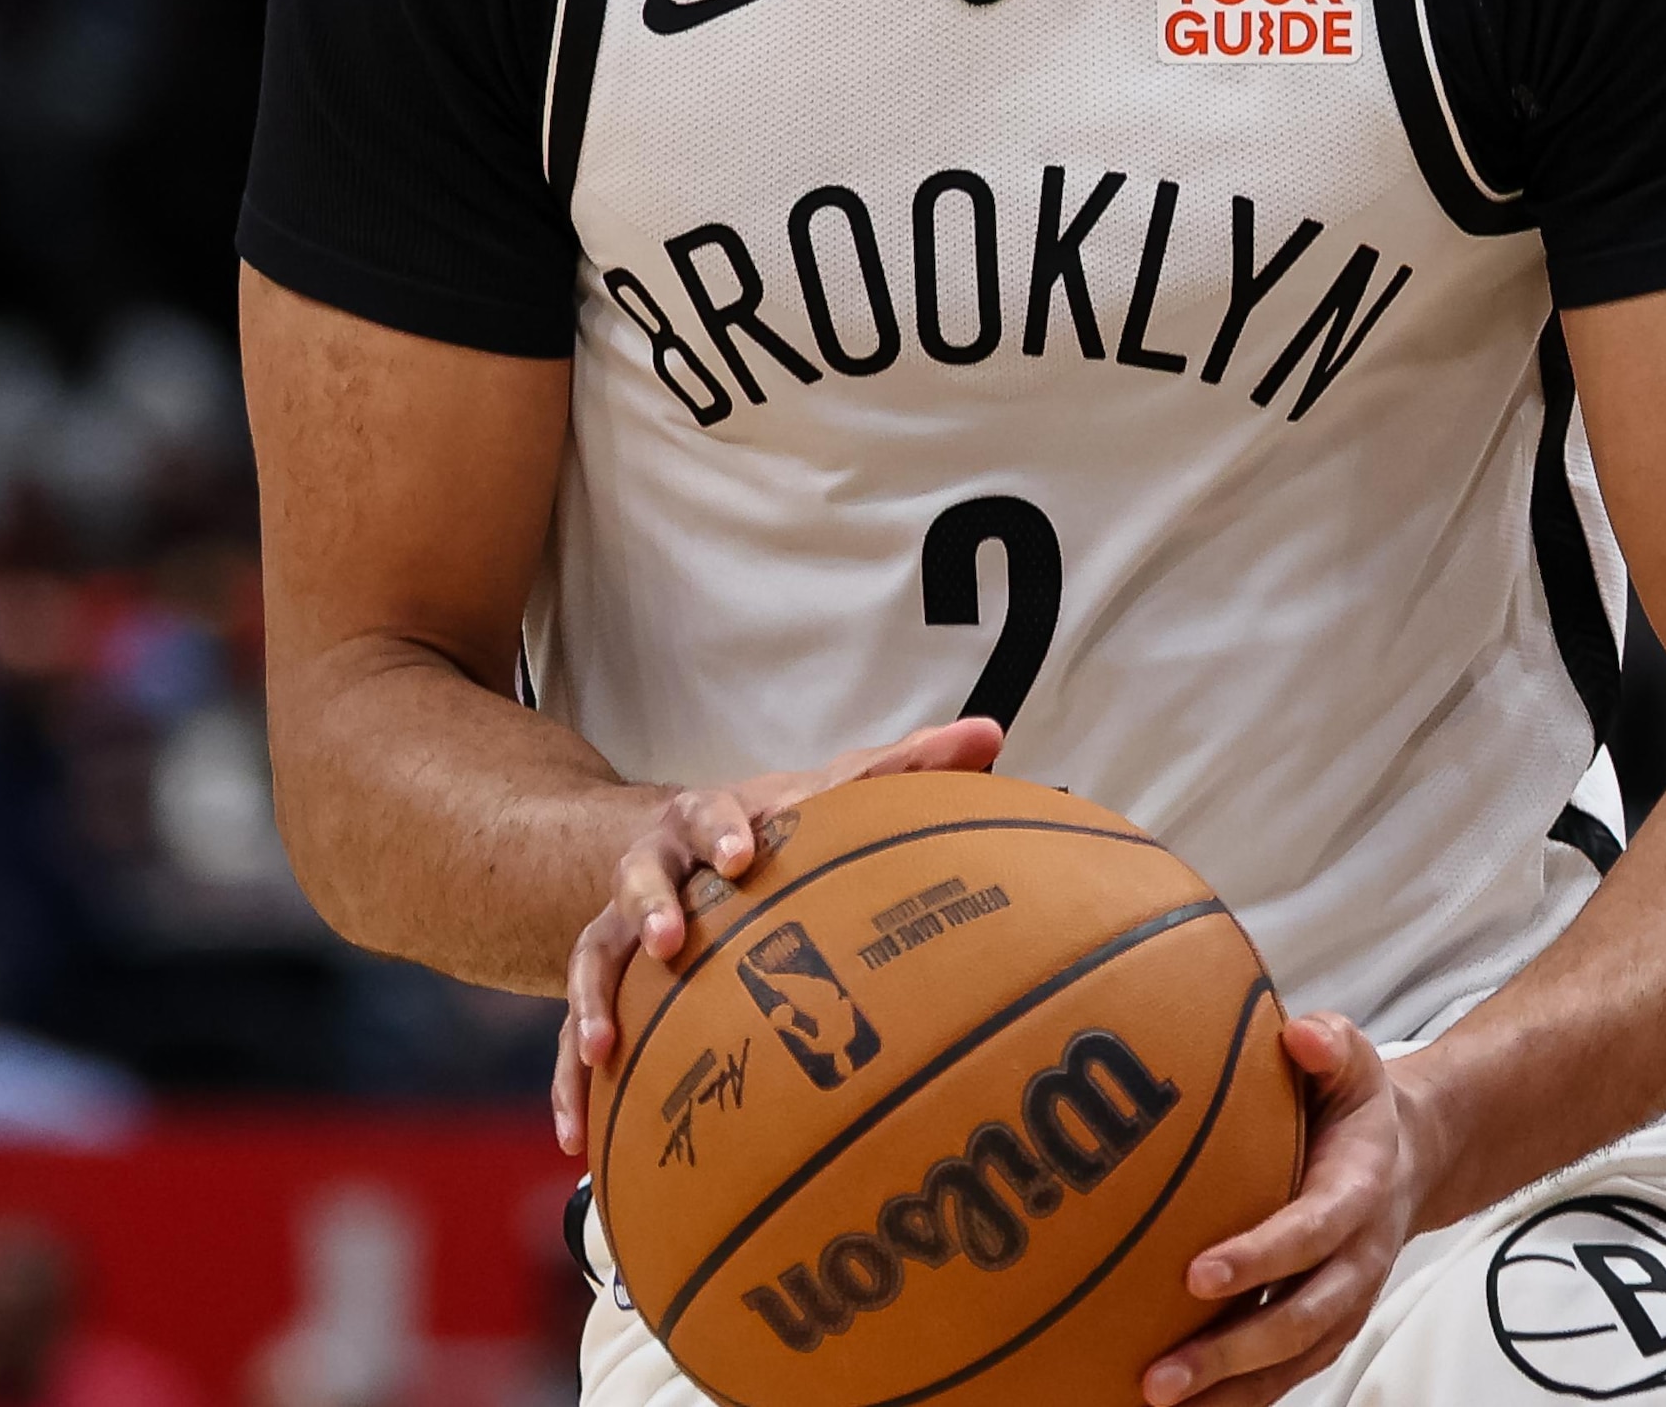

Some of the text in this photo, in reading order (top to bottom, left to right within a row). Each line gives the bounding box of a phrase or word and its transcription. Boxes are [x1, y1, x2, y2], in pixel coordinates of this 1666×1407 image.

[1165, 10, 1352, 56] GUIDE
[602, 165, 1413, 428] BROOKLYN
[921, 495, 1063, 774] 2
[741, 1026, 1181, 1353] Wilson
